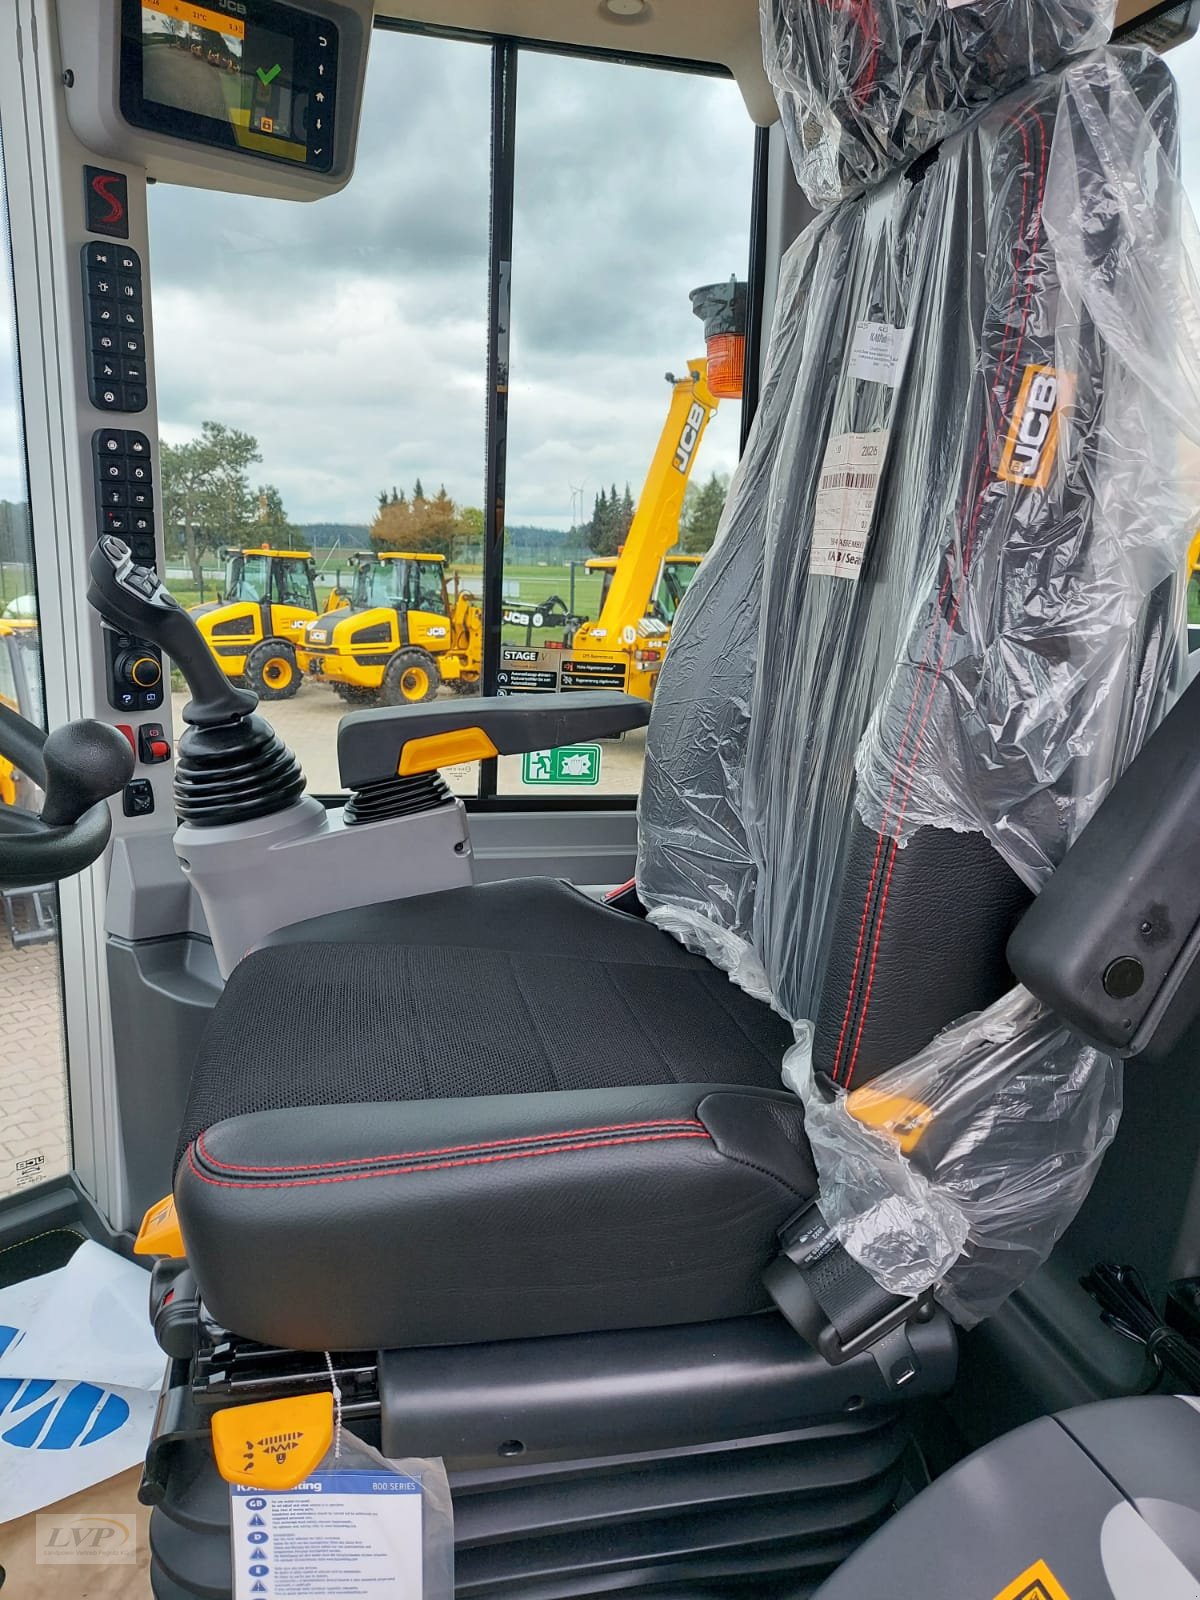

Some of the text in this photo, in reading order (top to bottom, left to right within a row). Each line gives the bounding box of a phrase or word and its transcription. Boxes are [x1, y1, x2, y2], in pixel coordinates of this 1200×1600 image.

[218, 0, 247, 15] JCB
[1012, 375, 1058, 477] JCB
[676, 401, 706, 474] JCB
[503, 609, 530, 626] JCB
[426, 627, 446, 637] JCB
[504, 651, 537, 661] STAGE
[372, 1482, 416, 1491] 800 SERIES
[249, 1500, 263, 1508] GB
